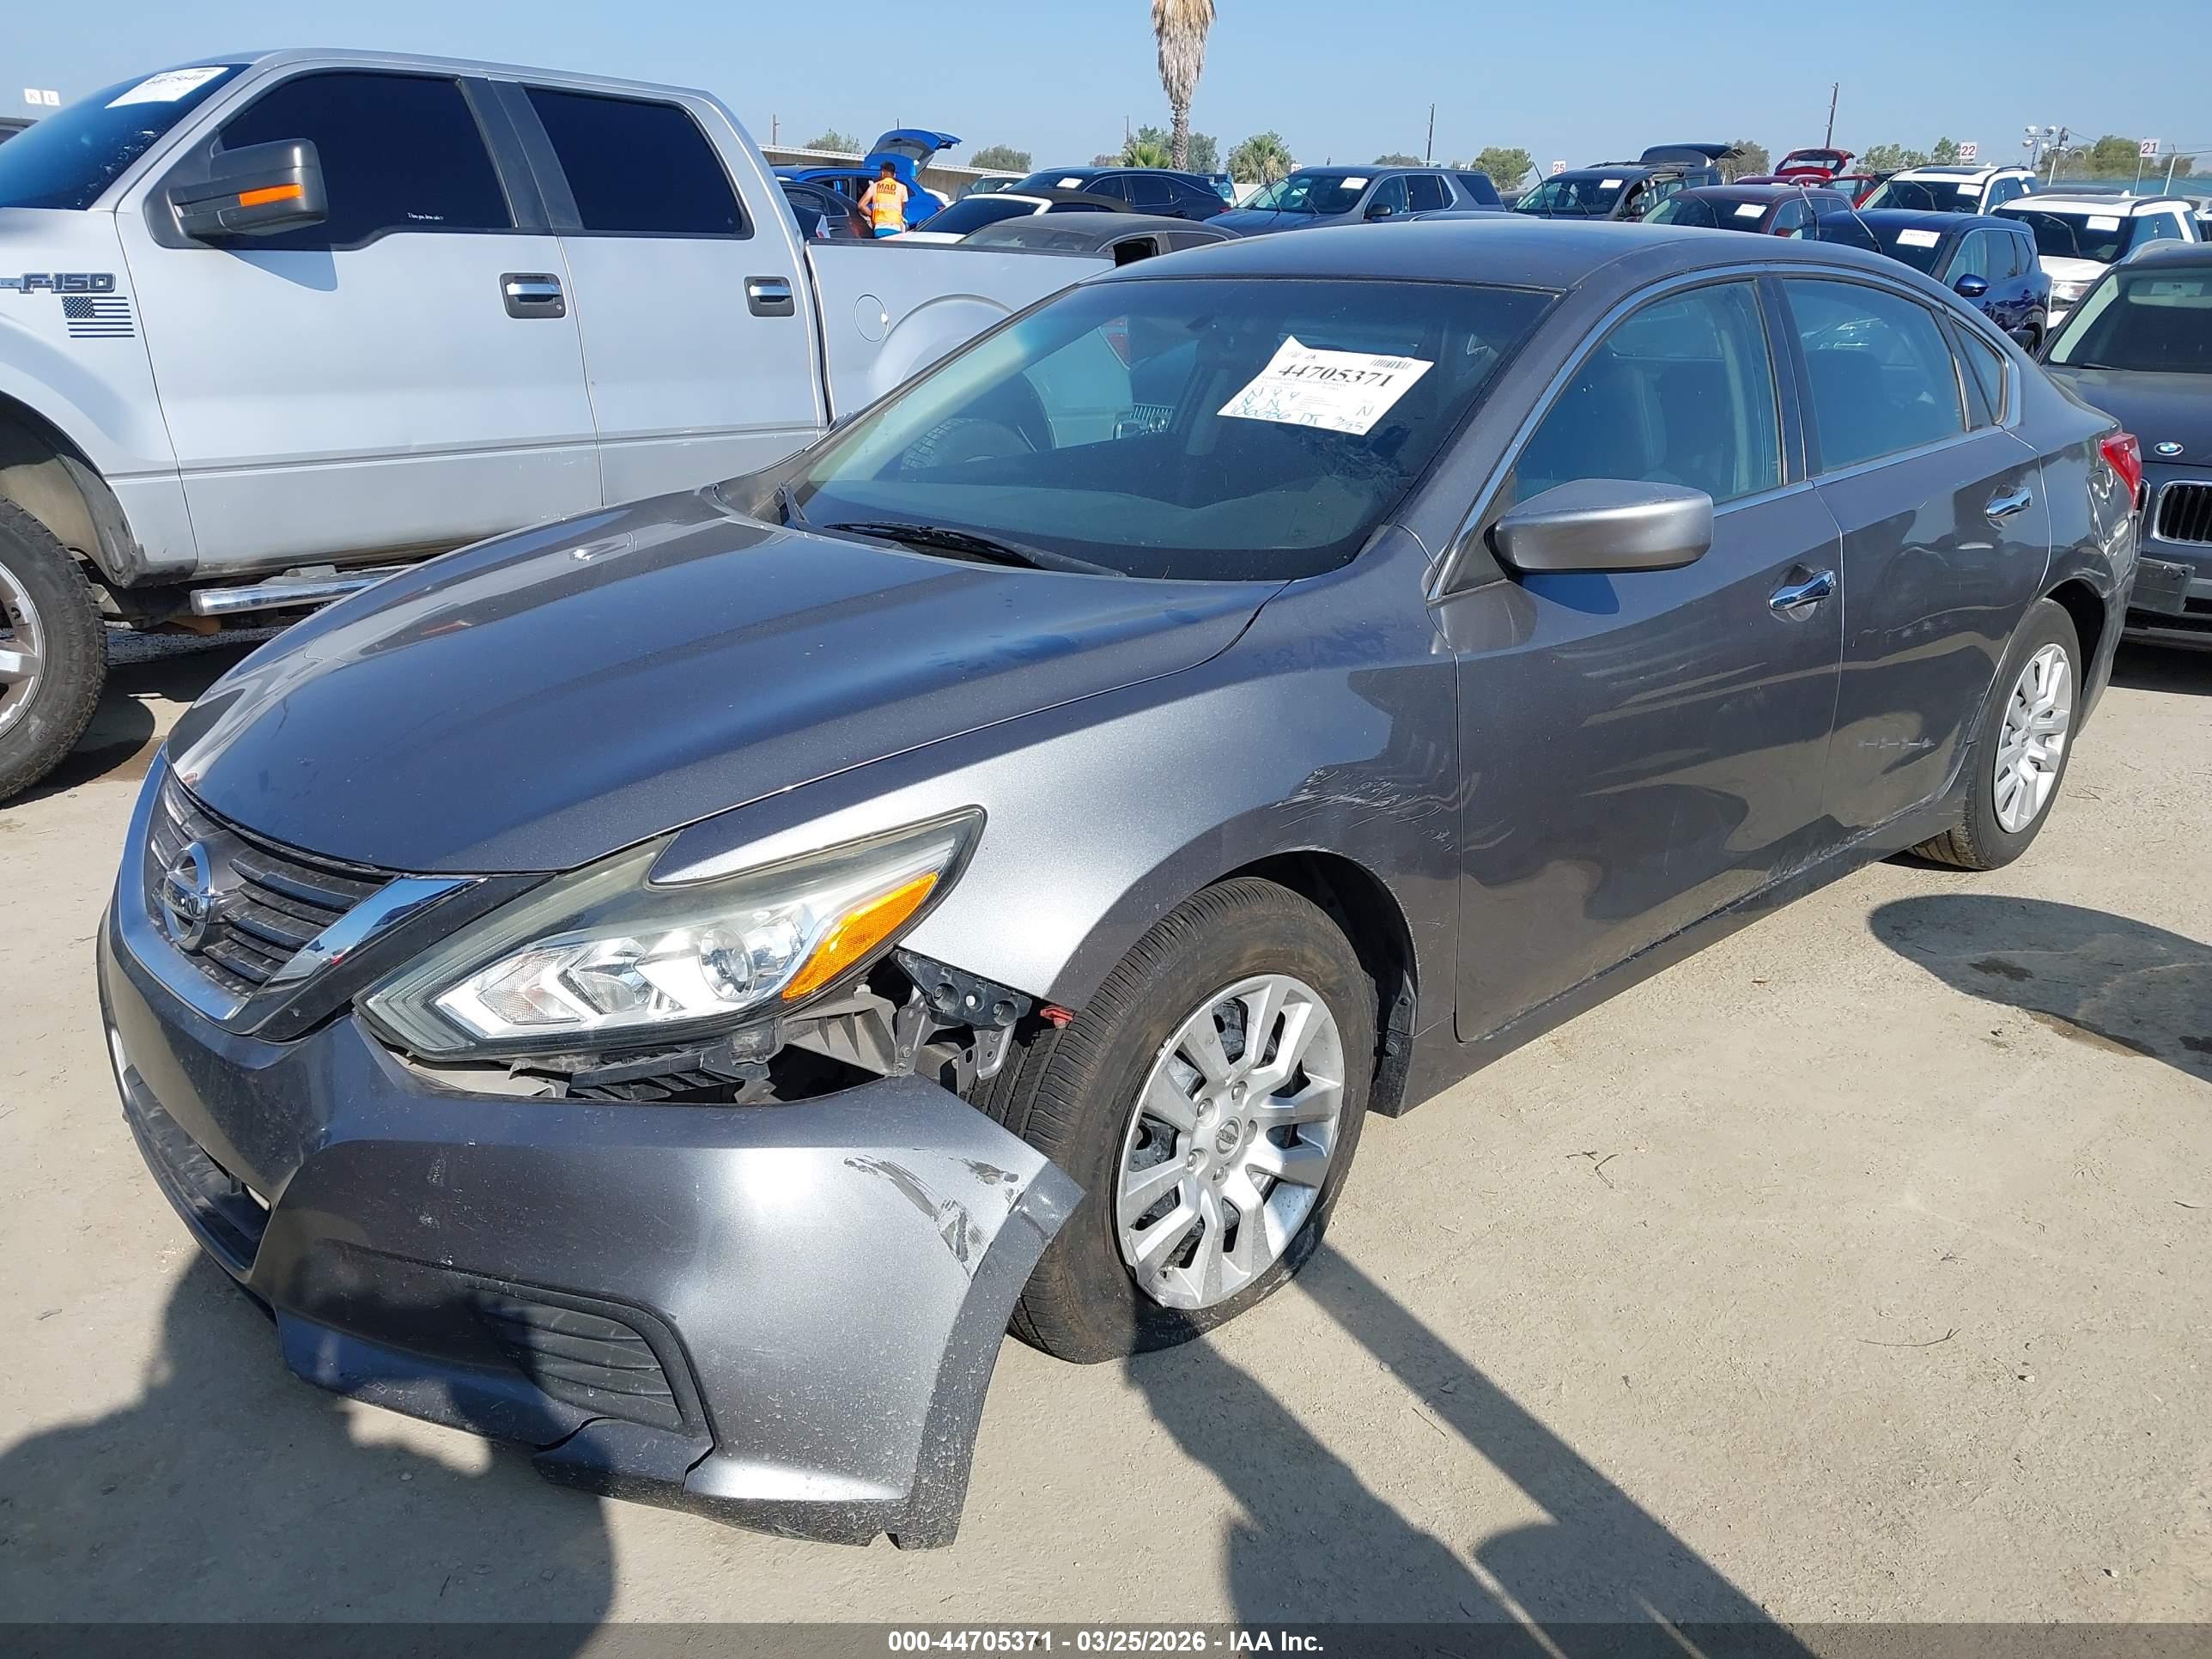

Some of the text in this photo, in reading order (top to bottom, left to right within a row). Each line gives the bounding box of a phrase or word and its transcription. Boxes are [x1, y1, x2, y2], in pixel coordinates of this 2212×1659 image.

[1961, 144, 1976, 156] 22
[2142, 142, 2158, 154] 21
[1553, 163, 1565, 173] 25
[20, 272, 116, 294] F-150
[1278, 363, 1395, 387] 44705371
